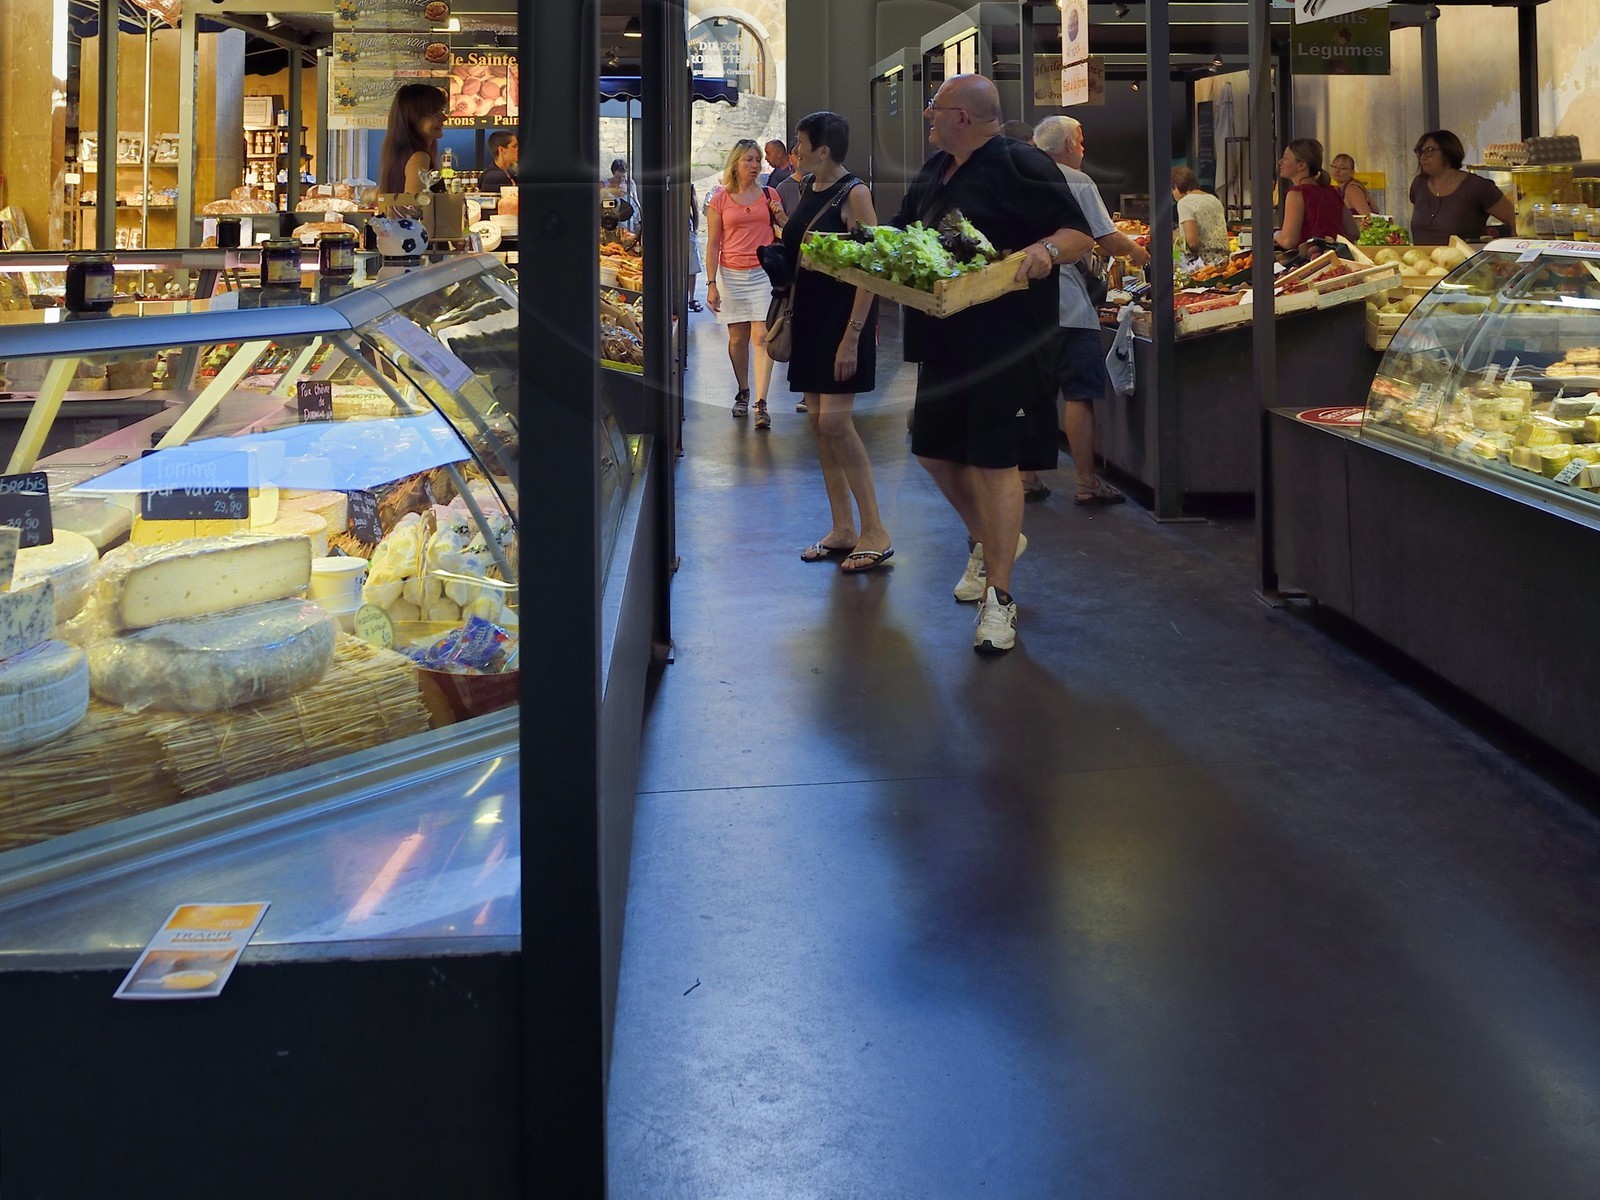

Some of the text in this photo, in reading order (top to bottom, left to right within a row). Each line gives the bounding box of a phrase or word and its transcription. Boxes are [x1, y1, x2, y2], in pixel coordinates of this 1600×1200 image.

[359, 37, 385, 49] HUILE
[404, 37, 430, 50] NOIX
[698, 41, 741, 51] DIRECT
[1297, 42, 1384, 60] Légumes
[467, 52, 518, 66] Sainte
[690, 55, 758, 64] RODUCTEUR
[442, 116, 475, 126] arons
[156, 456, 217, 480] Tomme
[184, 480, 233, 497] vache
[213, 500, 243, 514] 29,90
